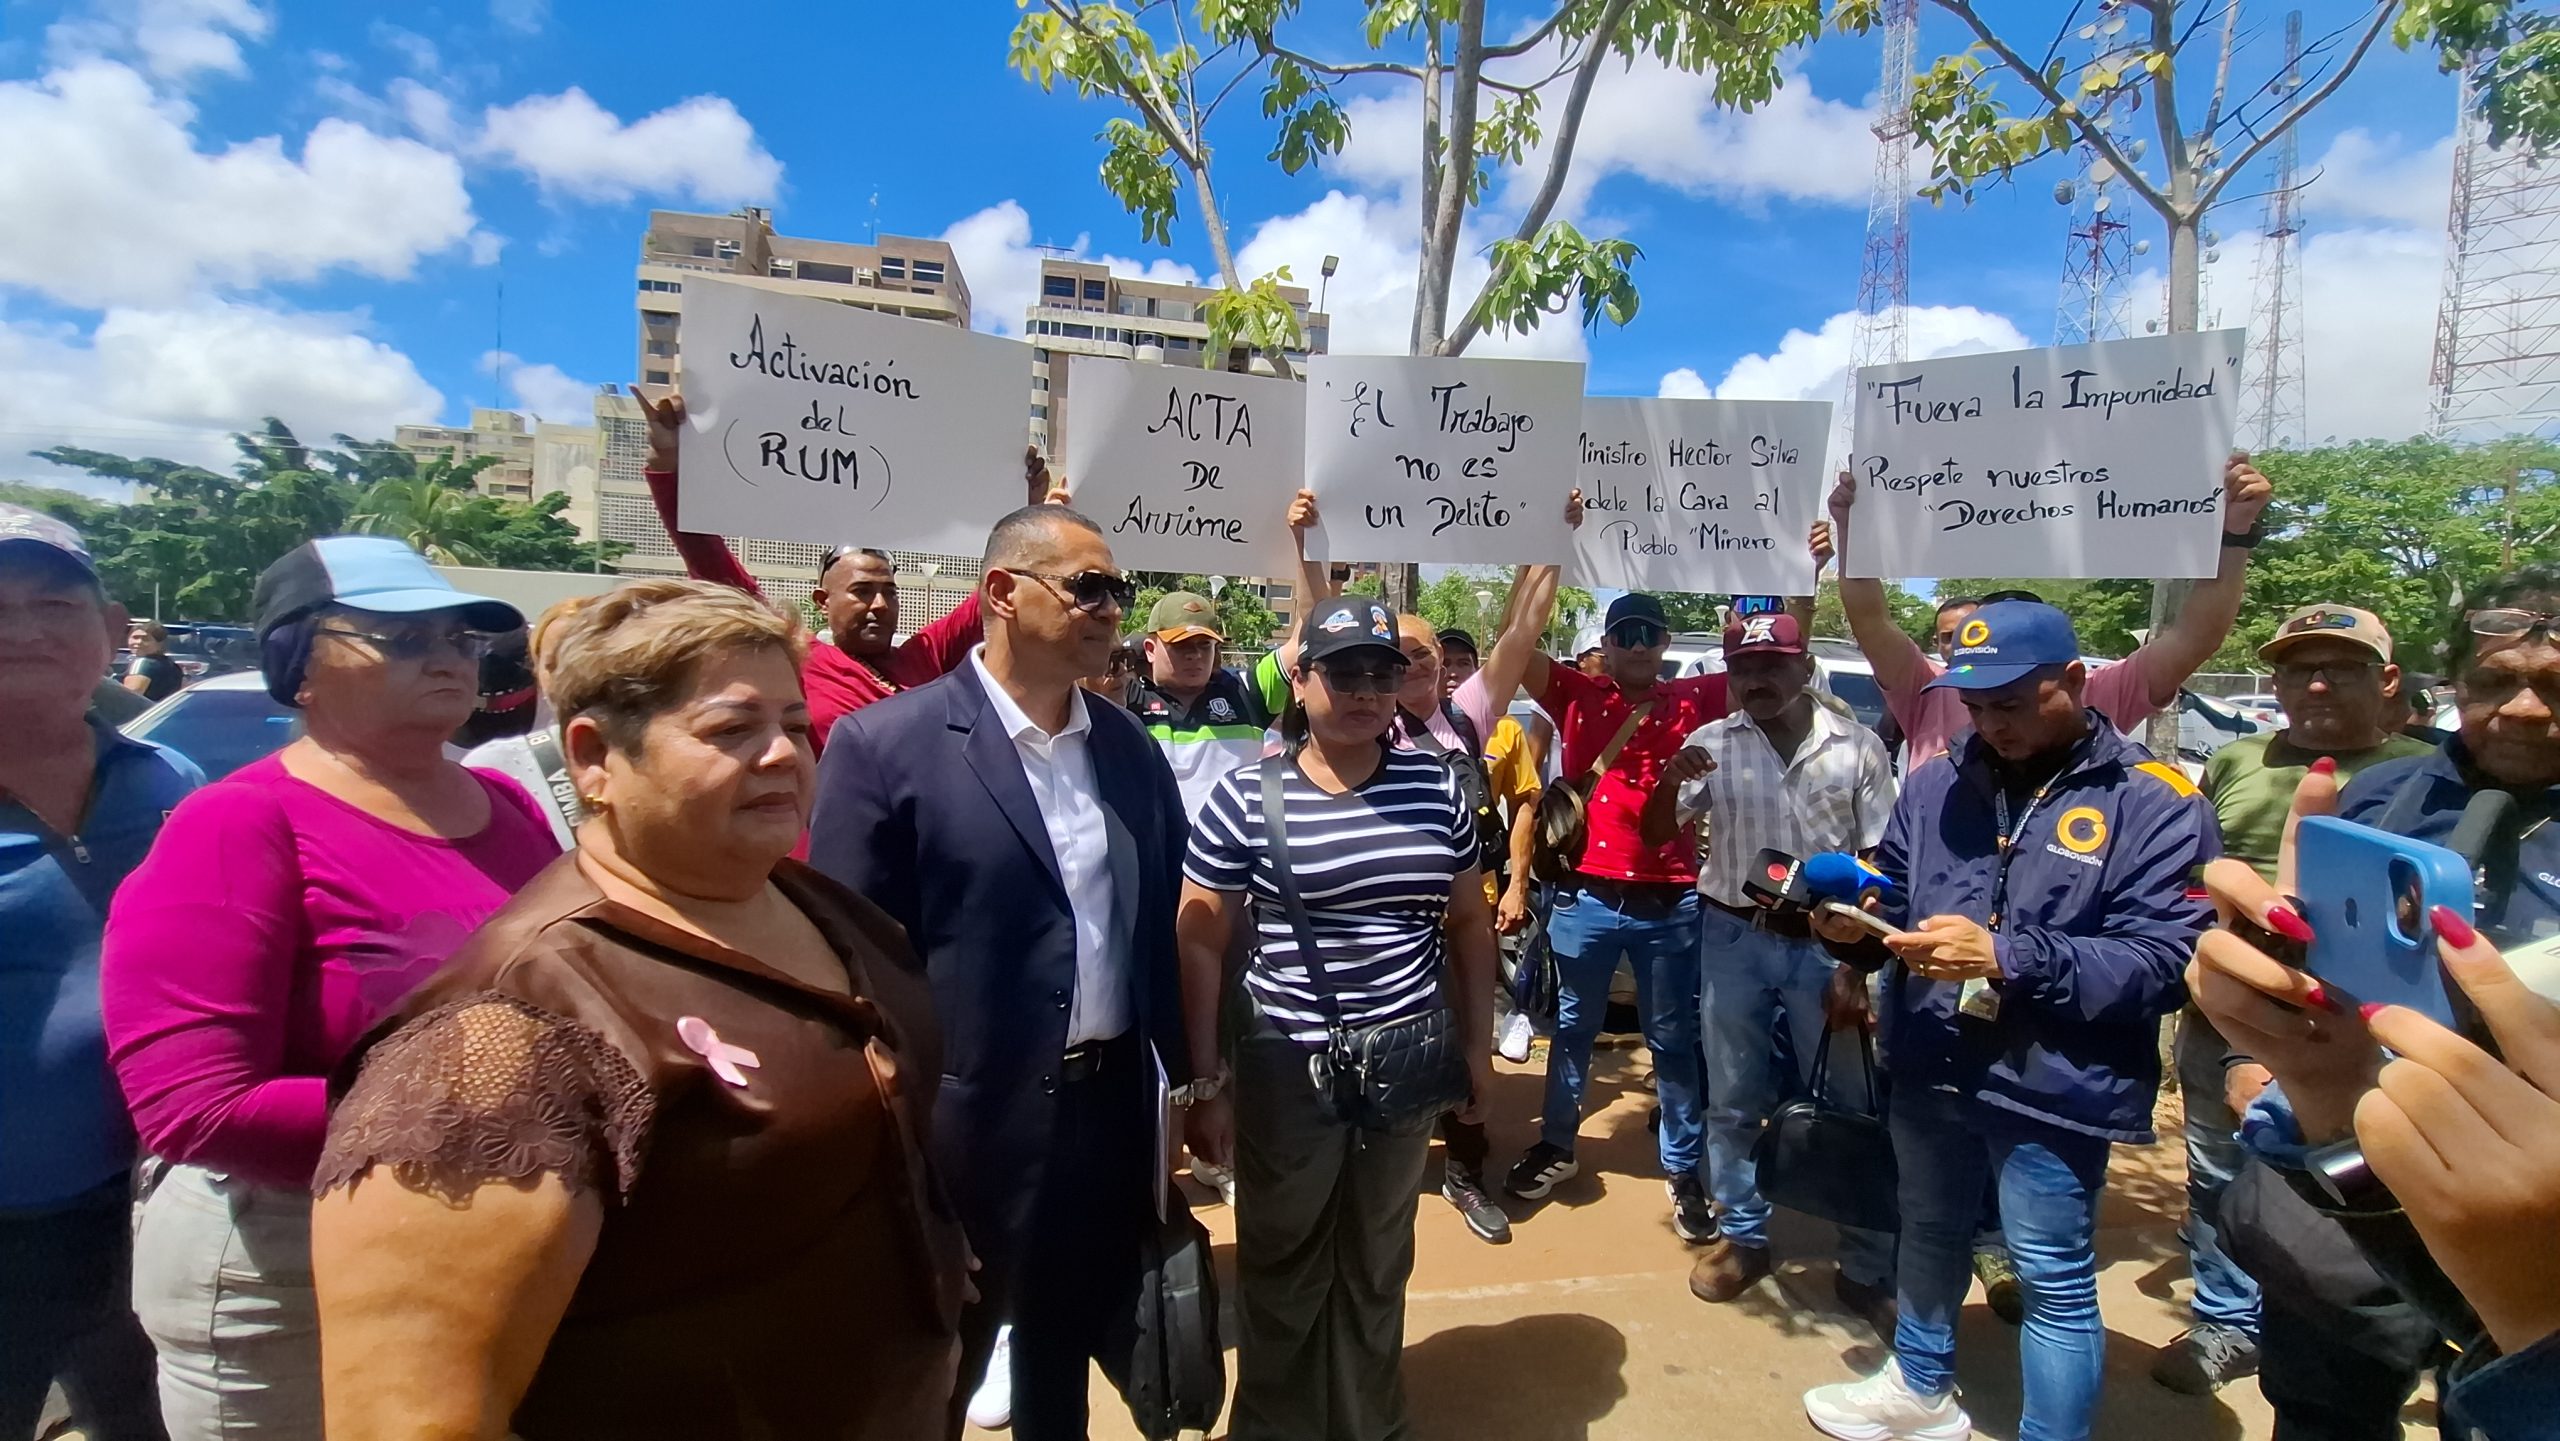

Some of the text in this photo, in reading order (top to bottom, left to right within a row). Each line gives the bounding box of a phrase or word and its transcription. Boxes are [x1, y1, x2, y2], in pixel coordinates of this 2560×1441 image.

[730, 312, 920, 400] Activación
[1867, 356, 2238, 425] "Fuera la Impunidad"
[801, 399, 857, 437] del
[1147, 386, 1252, 448] ACTA
[1431, 381, 1534, 453] Trabajo
[1394, 454, 1498, 482] no es
[1668, 436, 1734, 468] Hector
[1750, 434, 1800, 468] Silva
[1861, 455, 2110, 496] Respete nuestros
[1365, 490, 1527, 537] un Delito"
[1584, 479, 1780, 517] dele la Cara al
[1924, 486, 2224, 532] "Derechos Humanos"
[1112, 494, 1249, 544] Arrime
[1599, 519, 1776, 556] Pueblo "Minero
[1740, 629, 1775, 645] LA
[1741, 617, 1776, 633] VZ
